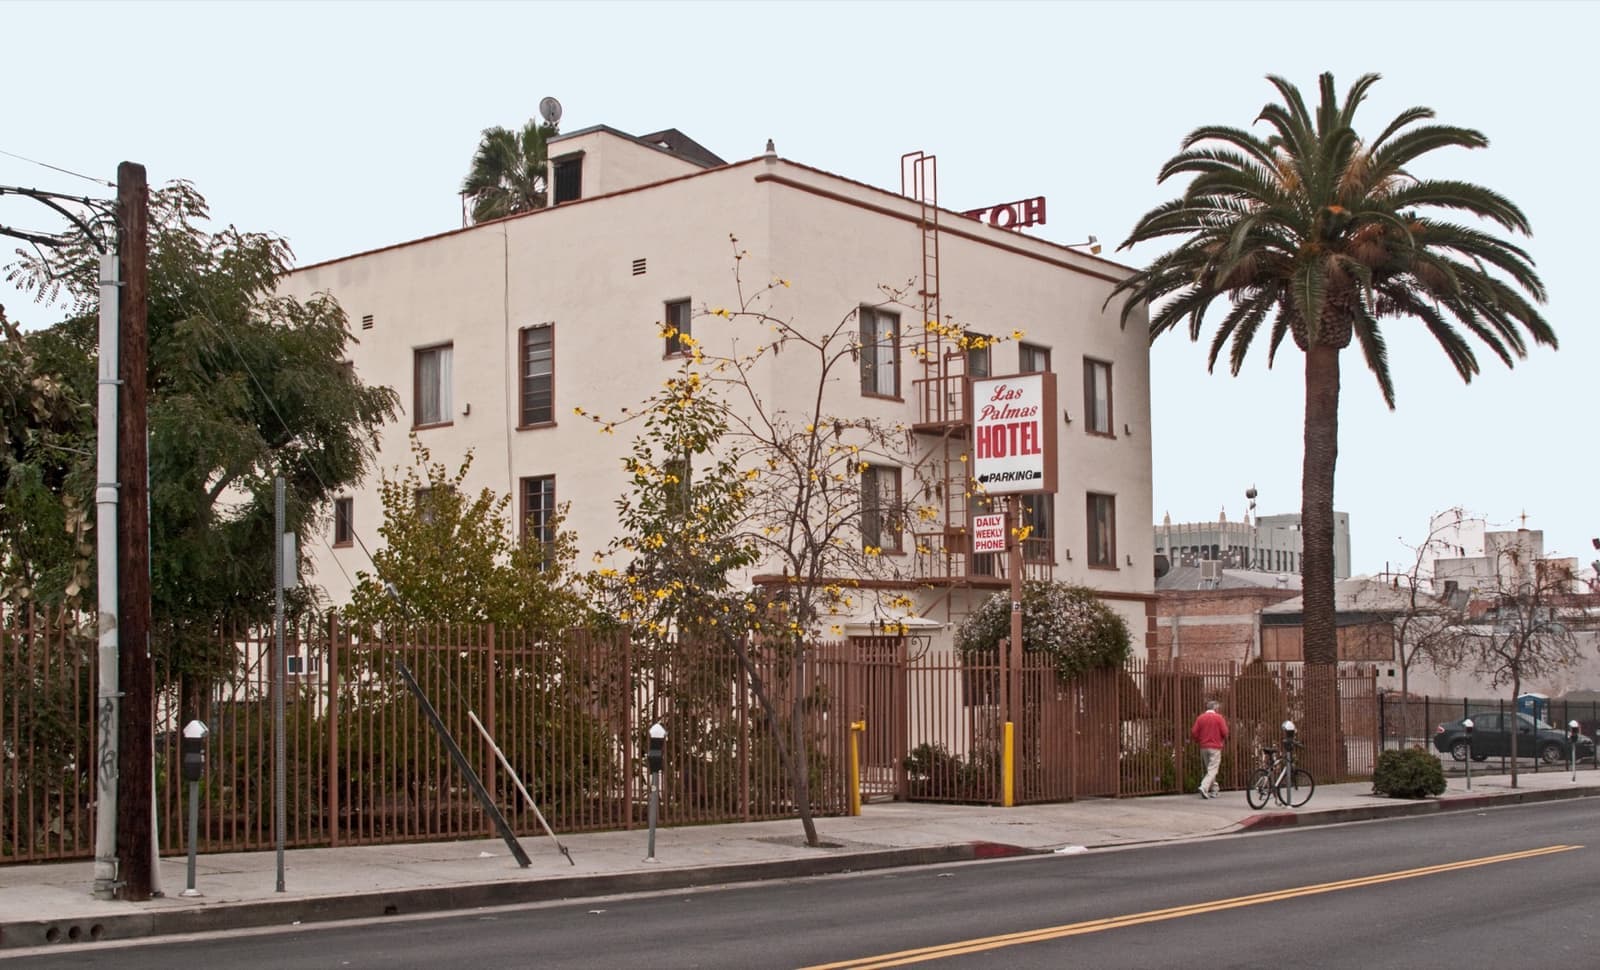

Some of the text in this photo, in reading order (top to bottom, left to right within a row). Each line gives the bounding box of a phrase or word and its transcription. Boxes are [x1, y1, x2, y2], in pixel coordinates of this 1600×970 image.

[991, 384, 1023, 401] Las
[978, 403, 1038, 422] Palmas
[977, 421, 1041, 459] HOTEL
[989, 470, 1033, 483] PARKING
[976, 516, 1001, 527] DAILY
[976, 528, 1003, 538] WEEKLY
[976, 540, 1004, 549] PHONE
